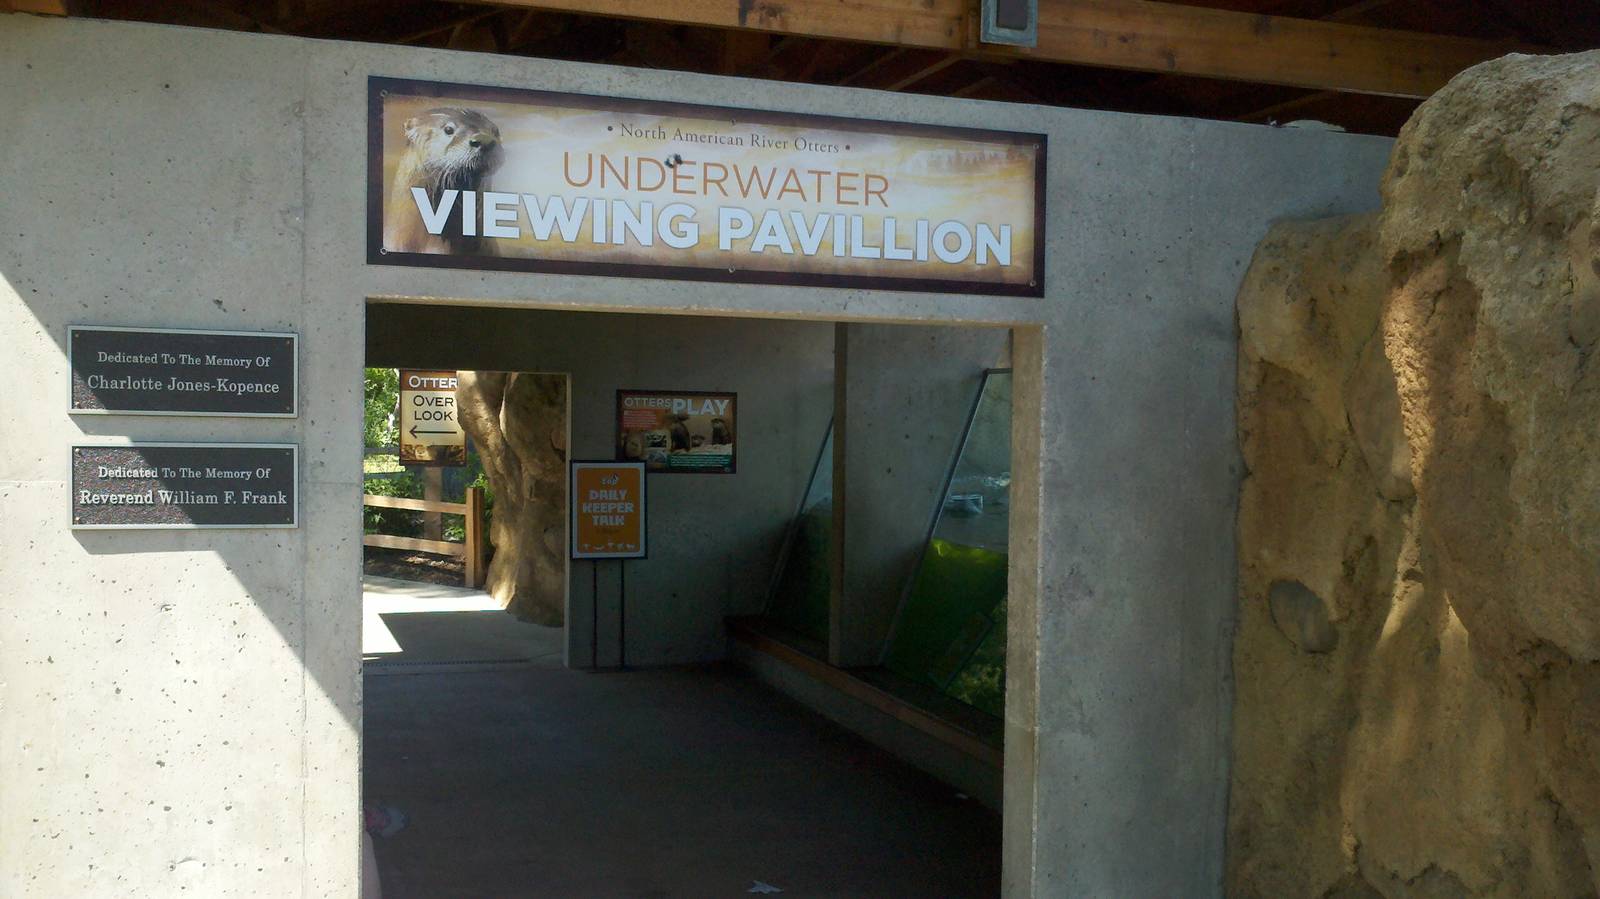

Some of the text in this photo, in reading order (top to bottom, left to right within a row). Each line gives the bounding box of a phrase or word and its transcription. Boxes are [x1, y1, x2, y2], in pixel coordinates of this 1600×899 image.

[621, 122, 840, 154] North American River Otters
[563, 151, 890, 208] UNDERWATER
[411, 186, 1012, 267] VIEWING PAVILLION
[97, 351, 271, 368] Dedicated To The Memory Of
[87, 375, 280, 395] Charlotte Jones-Kopence
[413, 395, 454, 407] OVER
[624, 397, 730, 416] OTTERS PLAY
[414, 410, 453, 421] LOOK
[98, 466, 271, 480] Dedicated To The Memory Of
[79, 490, 287, 505] Reverend William F. Frank
[588, 489, 628, 501] DAILY
[582, 502, 635, 513] KEEPER
[591, 514, 625, 526] TALK
